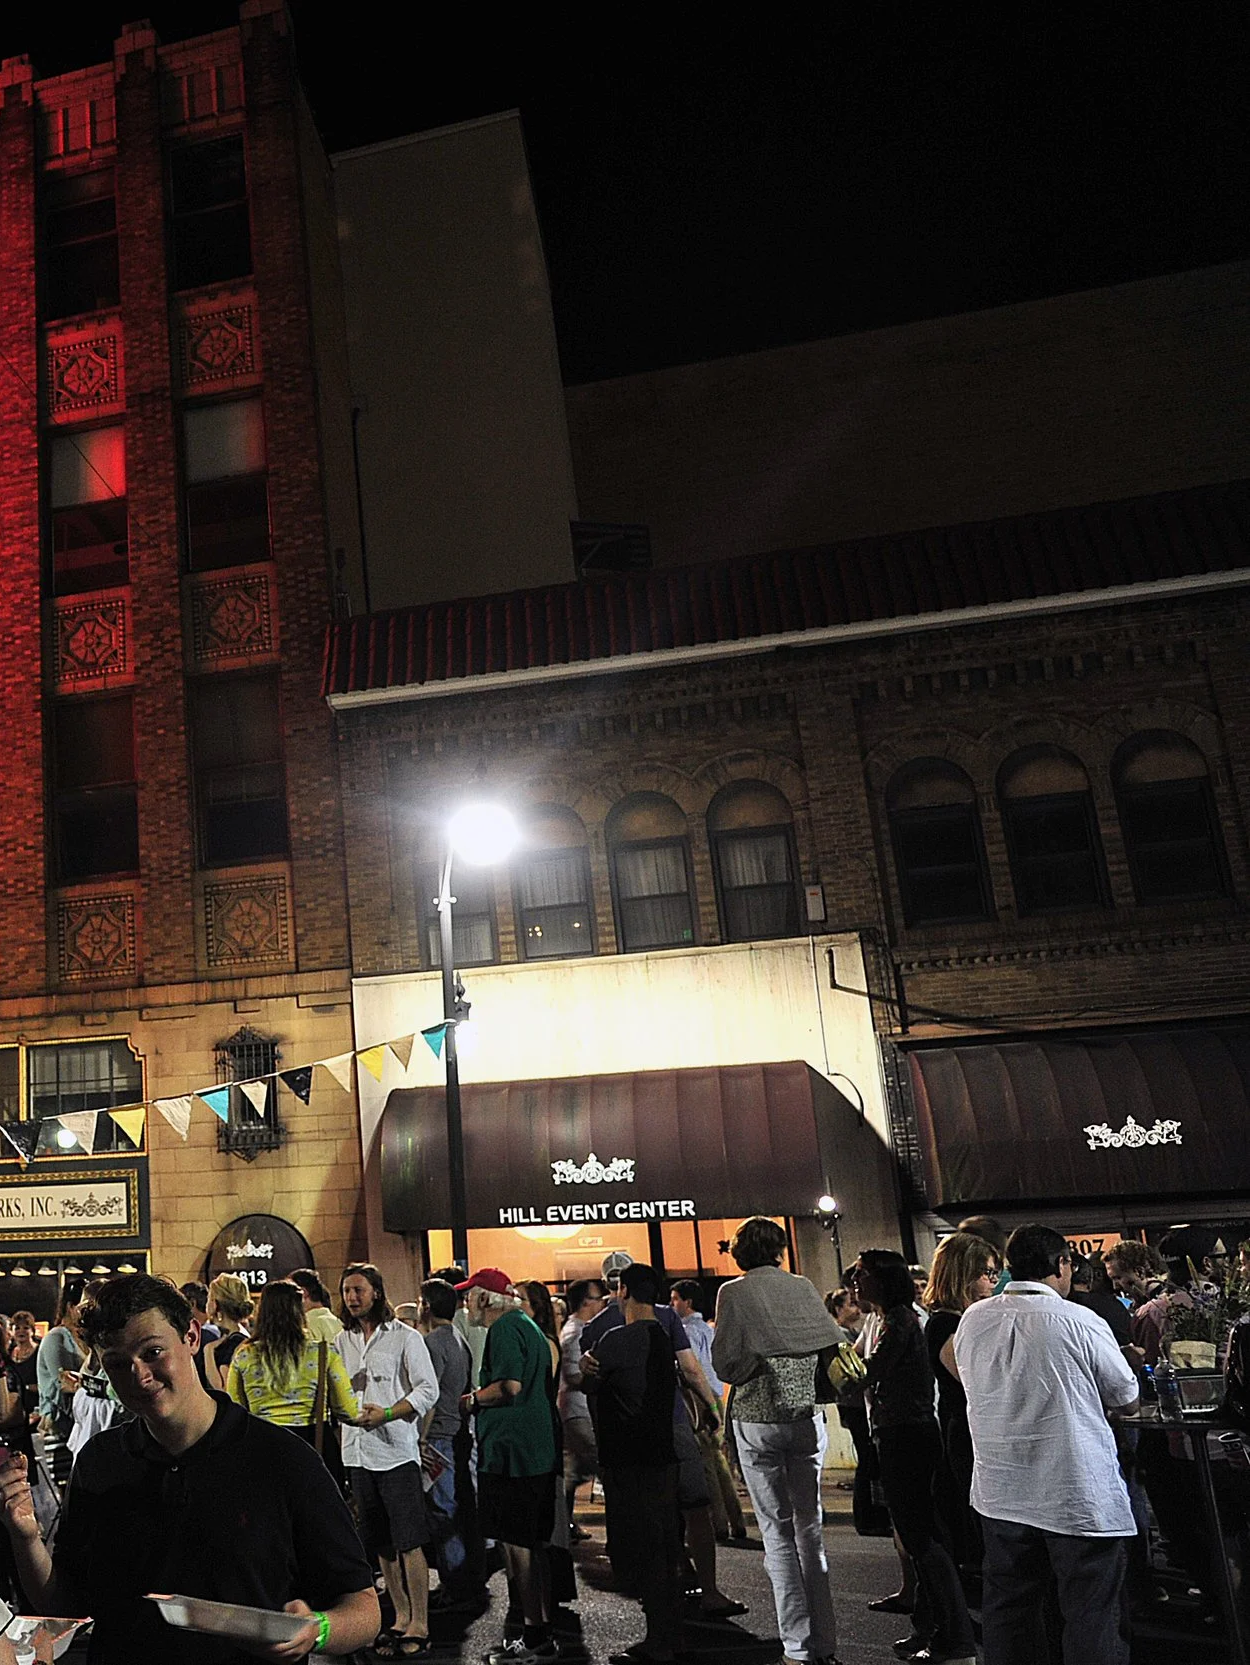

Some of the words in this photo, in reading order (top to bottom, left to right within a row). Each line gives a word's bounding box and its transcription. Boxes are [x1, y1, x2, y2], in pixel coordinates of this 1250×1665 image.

[30, 1196, 57, 1217] INC.
[499, 1206, 542, 1224] HILL
[546, 1203, 610, 1222] EVENT
[614, 1200, 696, 1219] CENTER
